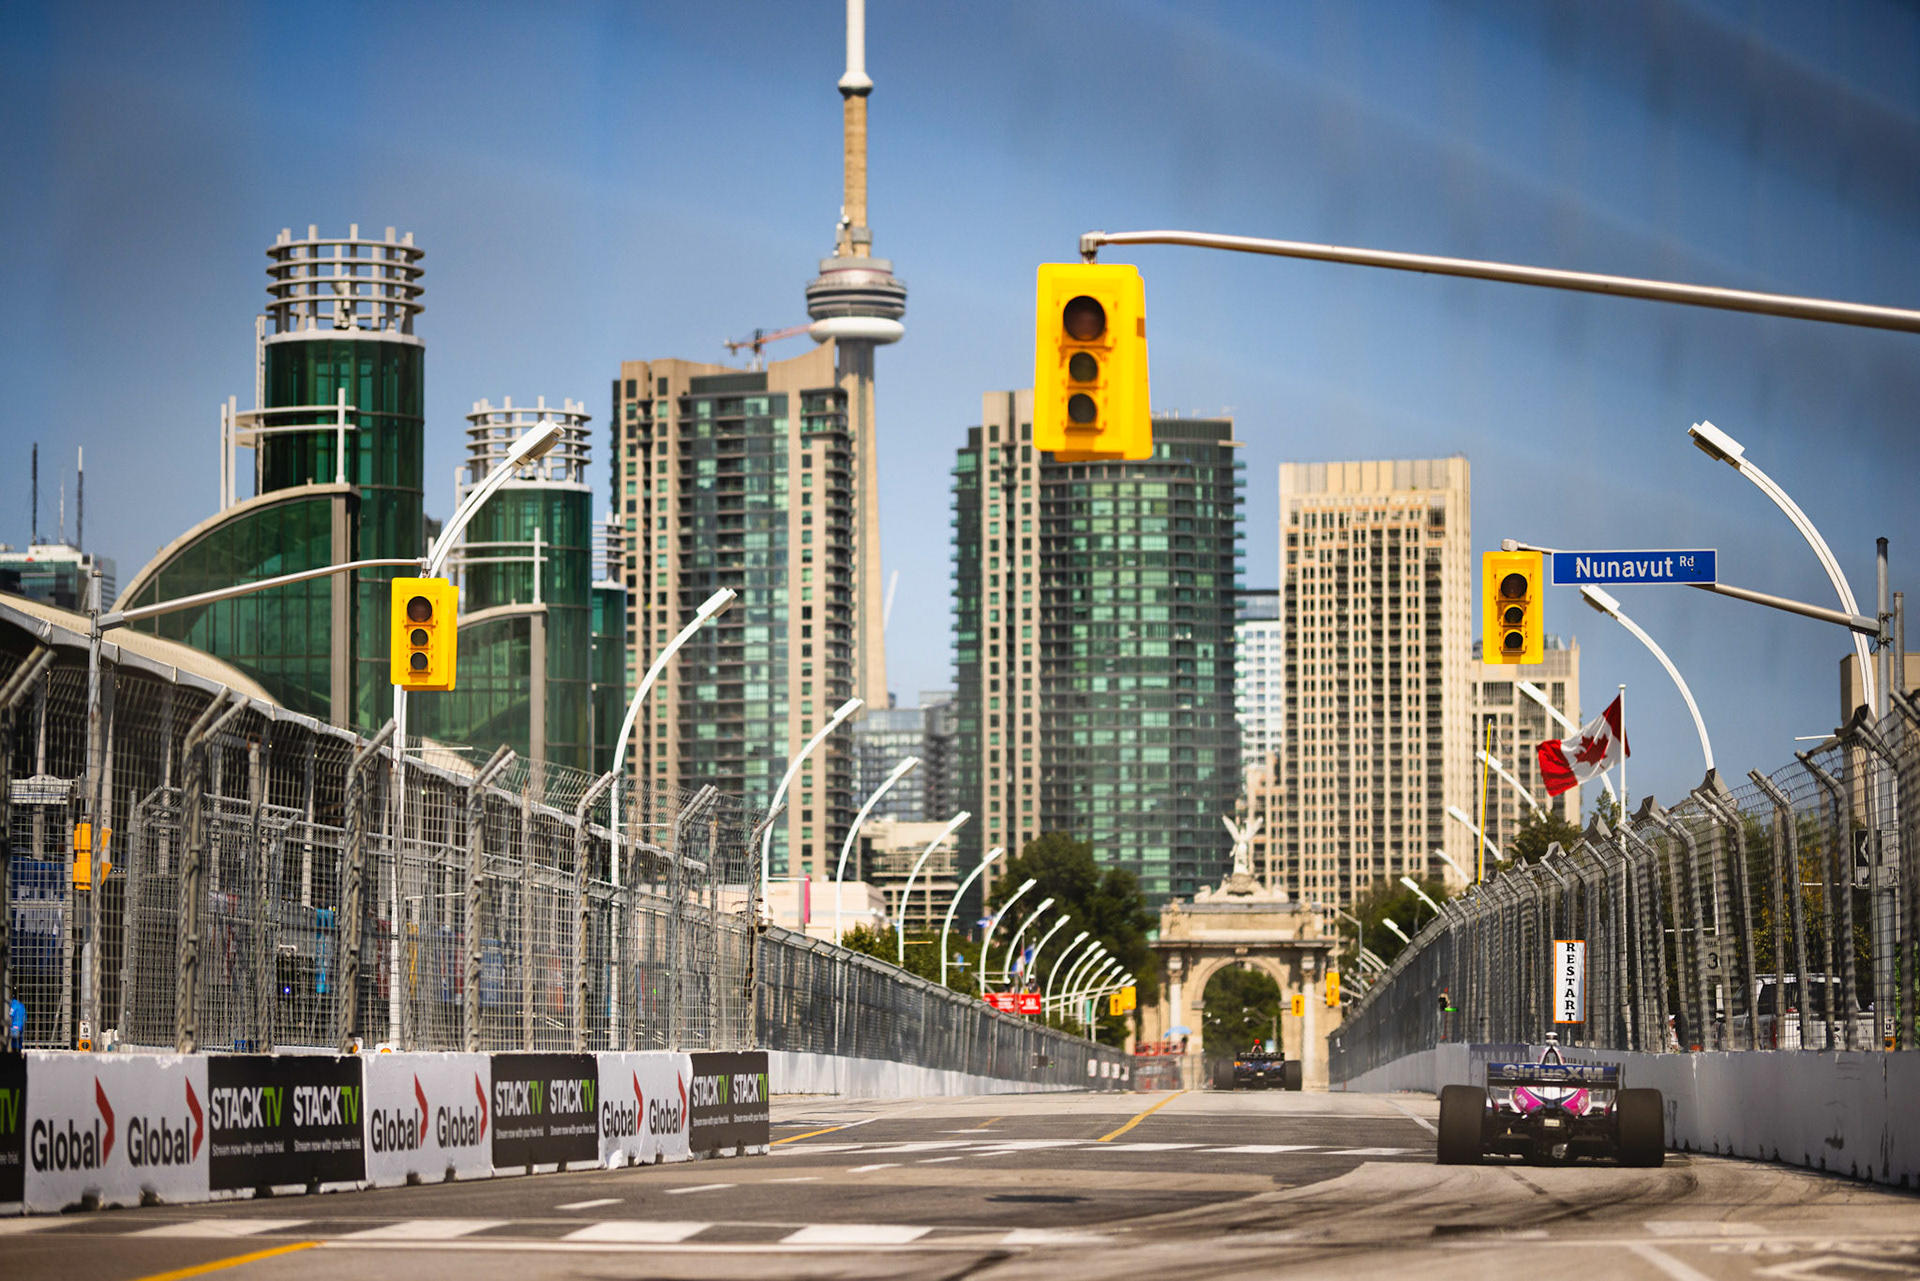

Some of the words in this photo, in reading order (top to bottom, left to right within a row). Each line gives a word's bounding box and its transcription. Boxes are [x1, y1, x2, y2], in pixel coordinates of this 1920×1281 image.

[1575, 556, 1674, 578] Nunavut
[1679, 555, 1694, 567] Rd
[1564, 943, 1576, 1021] RESTART
[693, 1074, 729, 1107] STACKTV
[733, 1073, 768, 1104] STACKTV
[1502, 1064, 1604, 1080] SiriusXM
[211, 1086, 284, 1130] STACKTV
[293, 1085, 360, 1127] STACKTV
[495, 1080, 544, 1117] STACKTV
[549, 1079, 595, 1114] STACKTV
[649, 1098, 680, 1135] Global
[371, 1108, 419, 1153] Global
[437, 1105, 479, 1148] Global
[602, 1099, 636, 1139] Global
[31, 1118, 100, 1172] Global
[127, 1116, 190, 1168] Global
